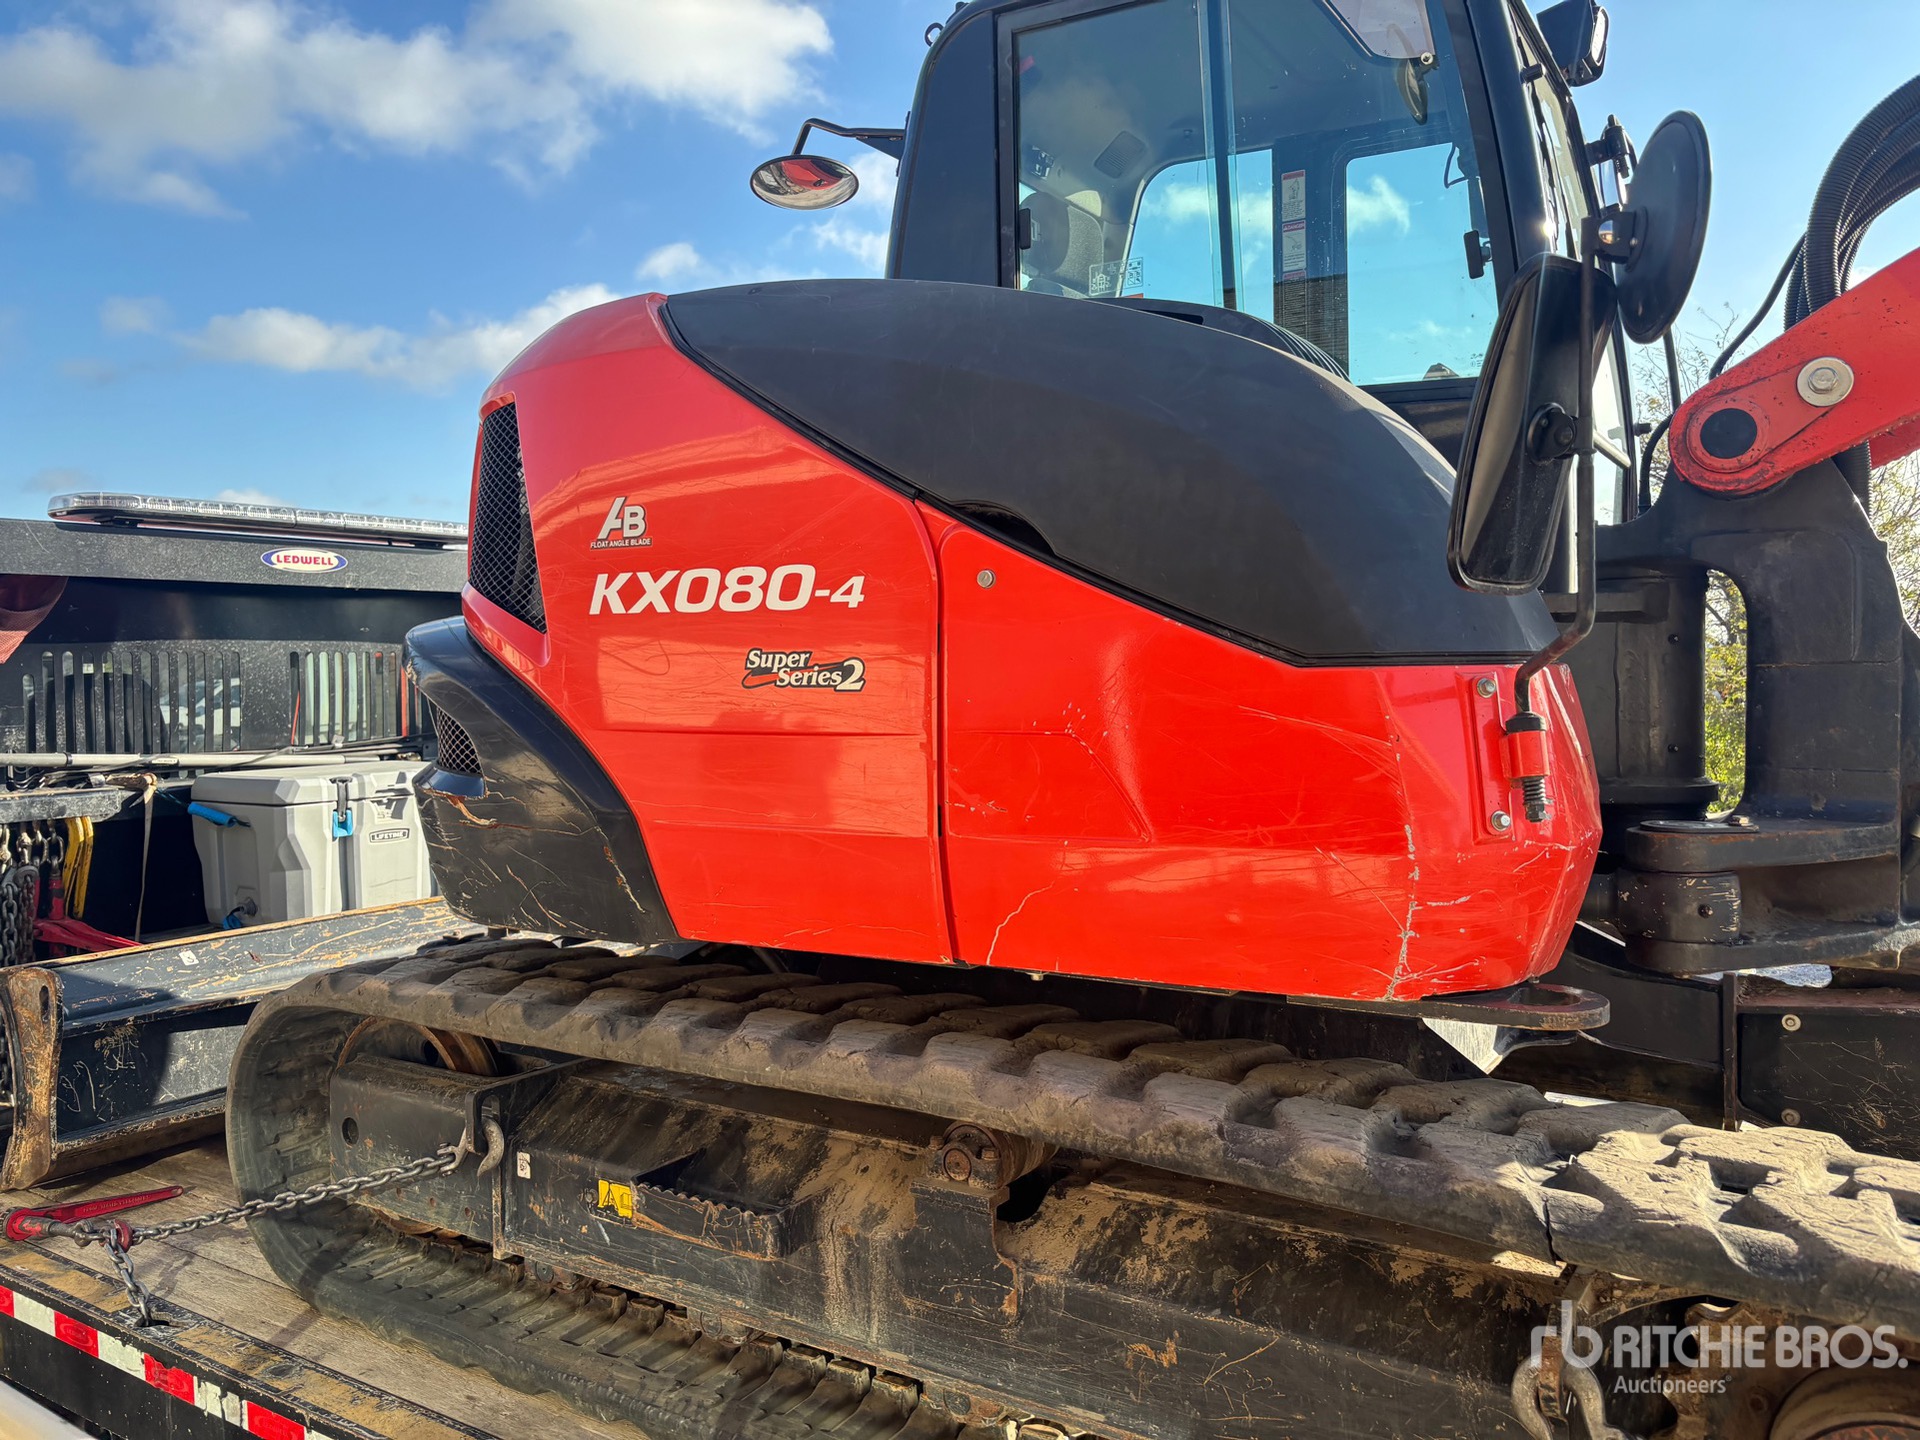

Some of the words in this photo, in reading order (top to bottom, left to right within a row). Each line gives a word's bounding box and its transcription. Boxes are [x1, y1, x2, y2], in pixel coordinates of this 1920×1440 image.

[597, 496, 647, 540] AB
[591, 540, 608, 549] FLOAT
[610, 539, 629, 547] ANGLE
[631, 538, 651, 546] BLADE
[276, 554, 334, 566] LEDWELL
[589, 564, 866, 615] KX080-4
[746, 649, 811, 673] Super
[776, 665, 842, 686] Series
